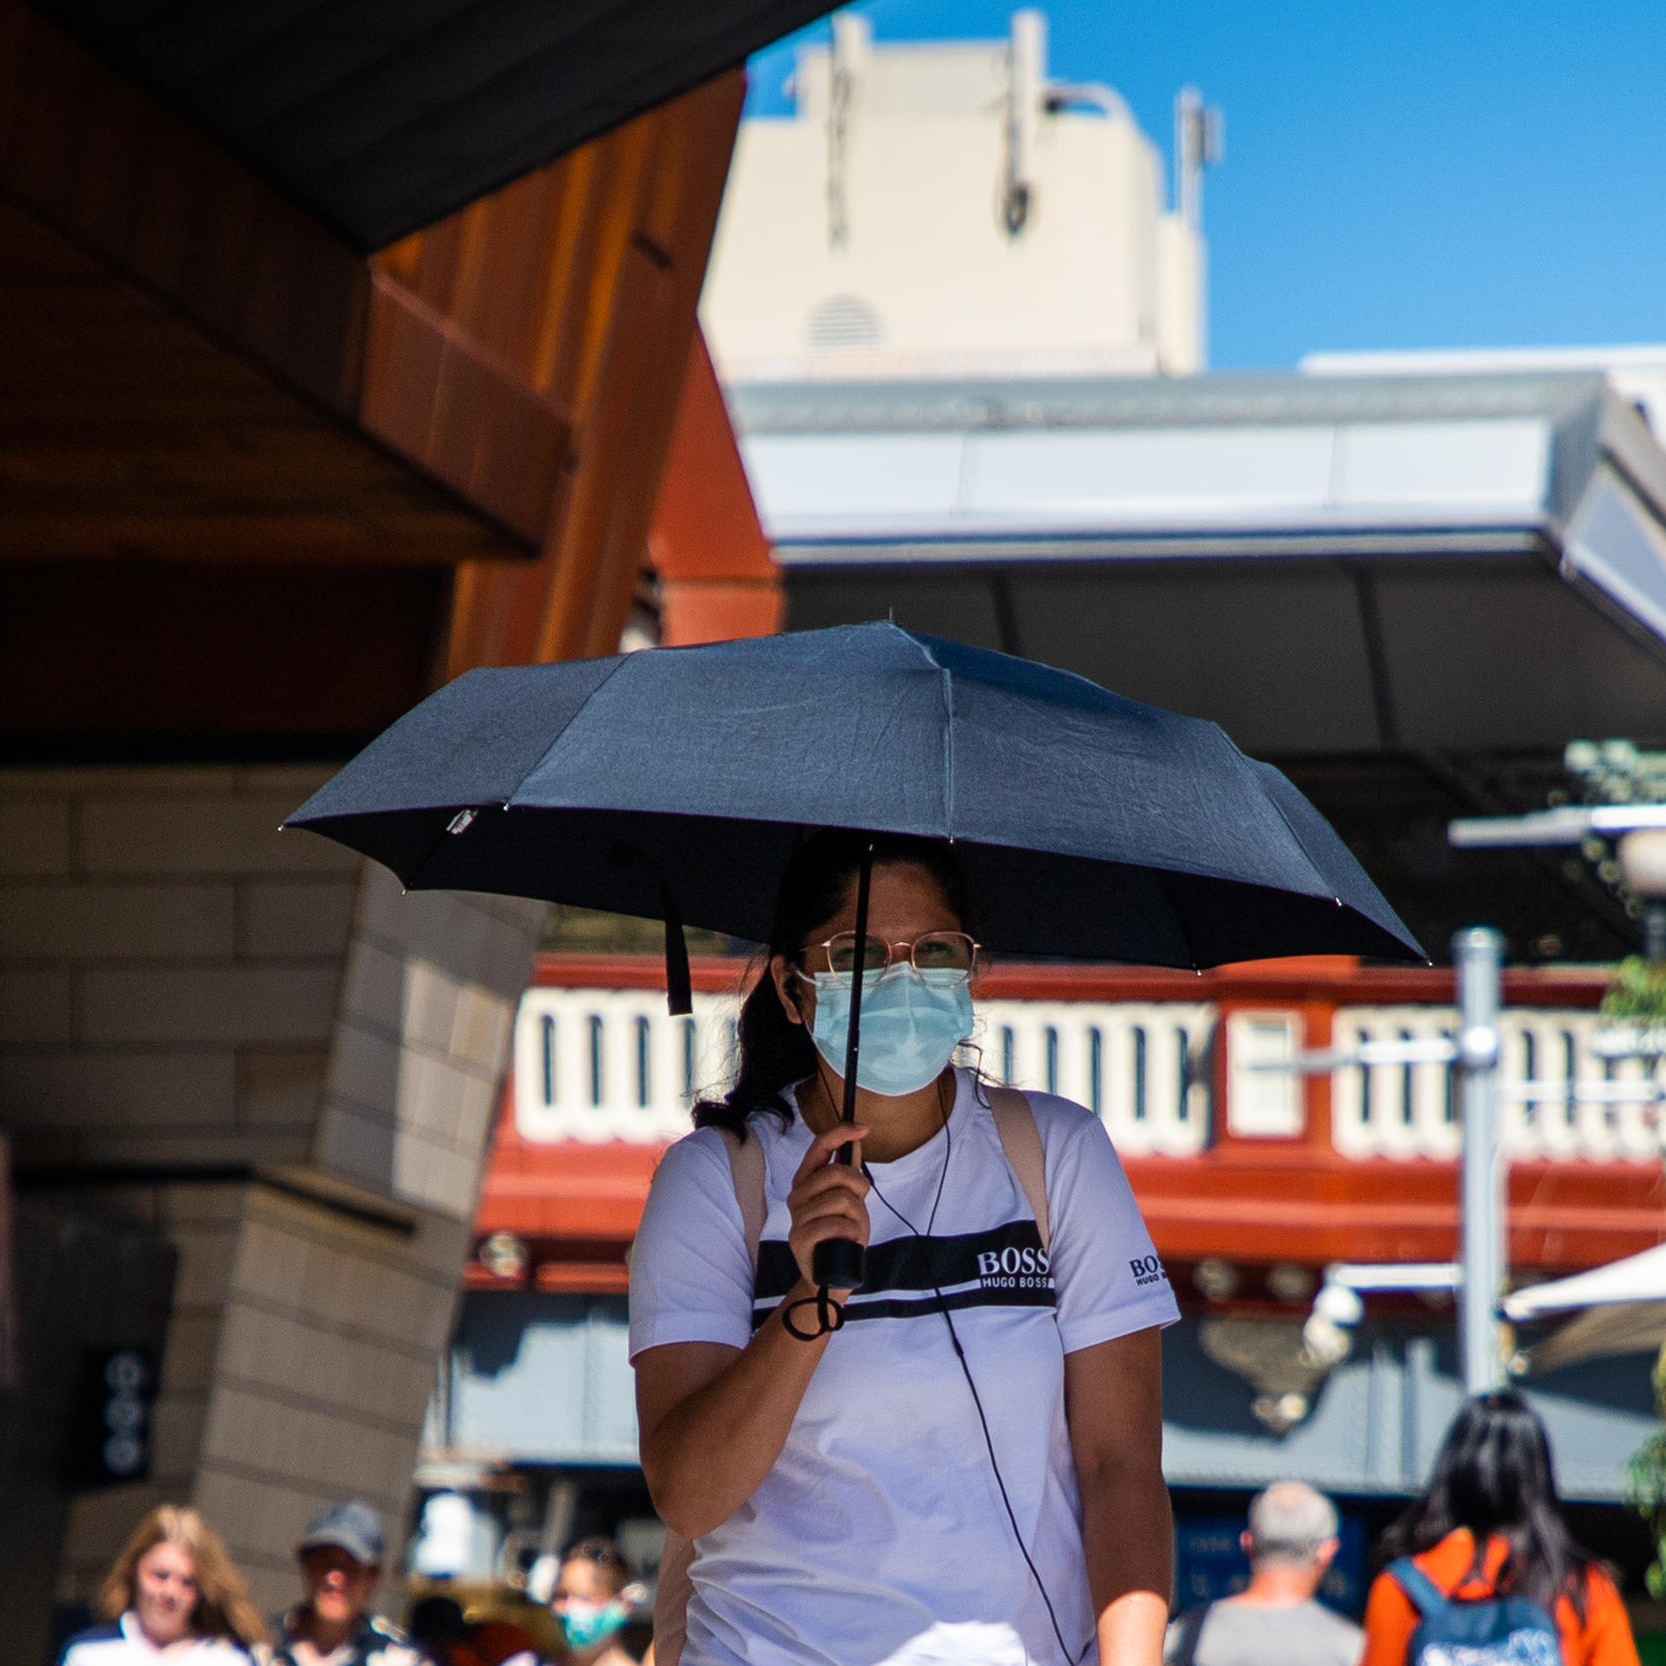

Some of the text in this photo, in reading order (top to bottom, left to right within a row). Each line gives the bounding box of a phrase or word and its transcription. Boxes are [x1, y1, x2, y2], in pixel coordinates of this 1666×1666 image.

[977, 1247, 1050, 1275] BOSS
[1129, 1254, 1165, 1278] BO
[982, 1277, 1047, 1288] HUGO BOSS
[1136, 1274, 1160, 1286] HUGO
